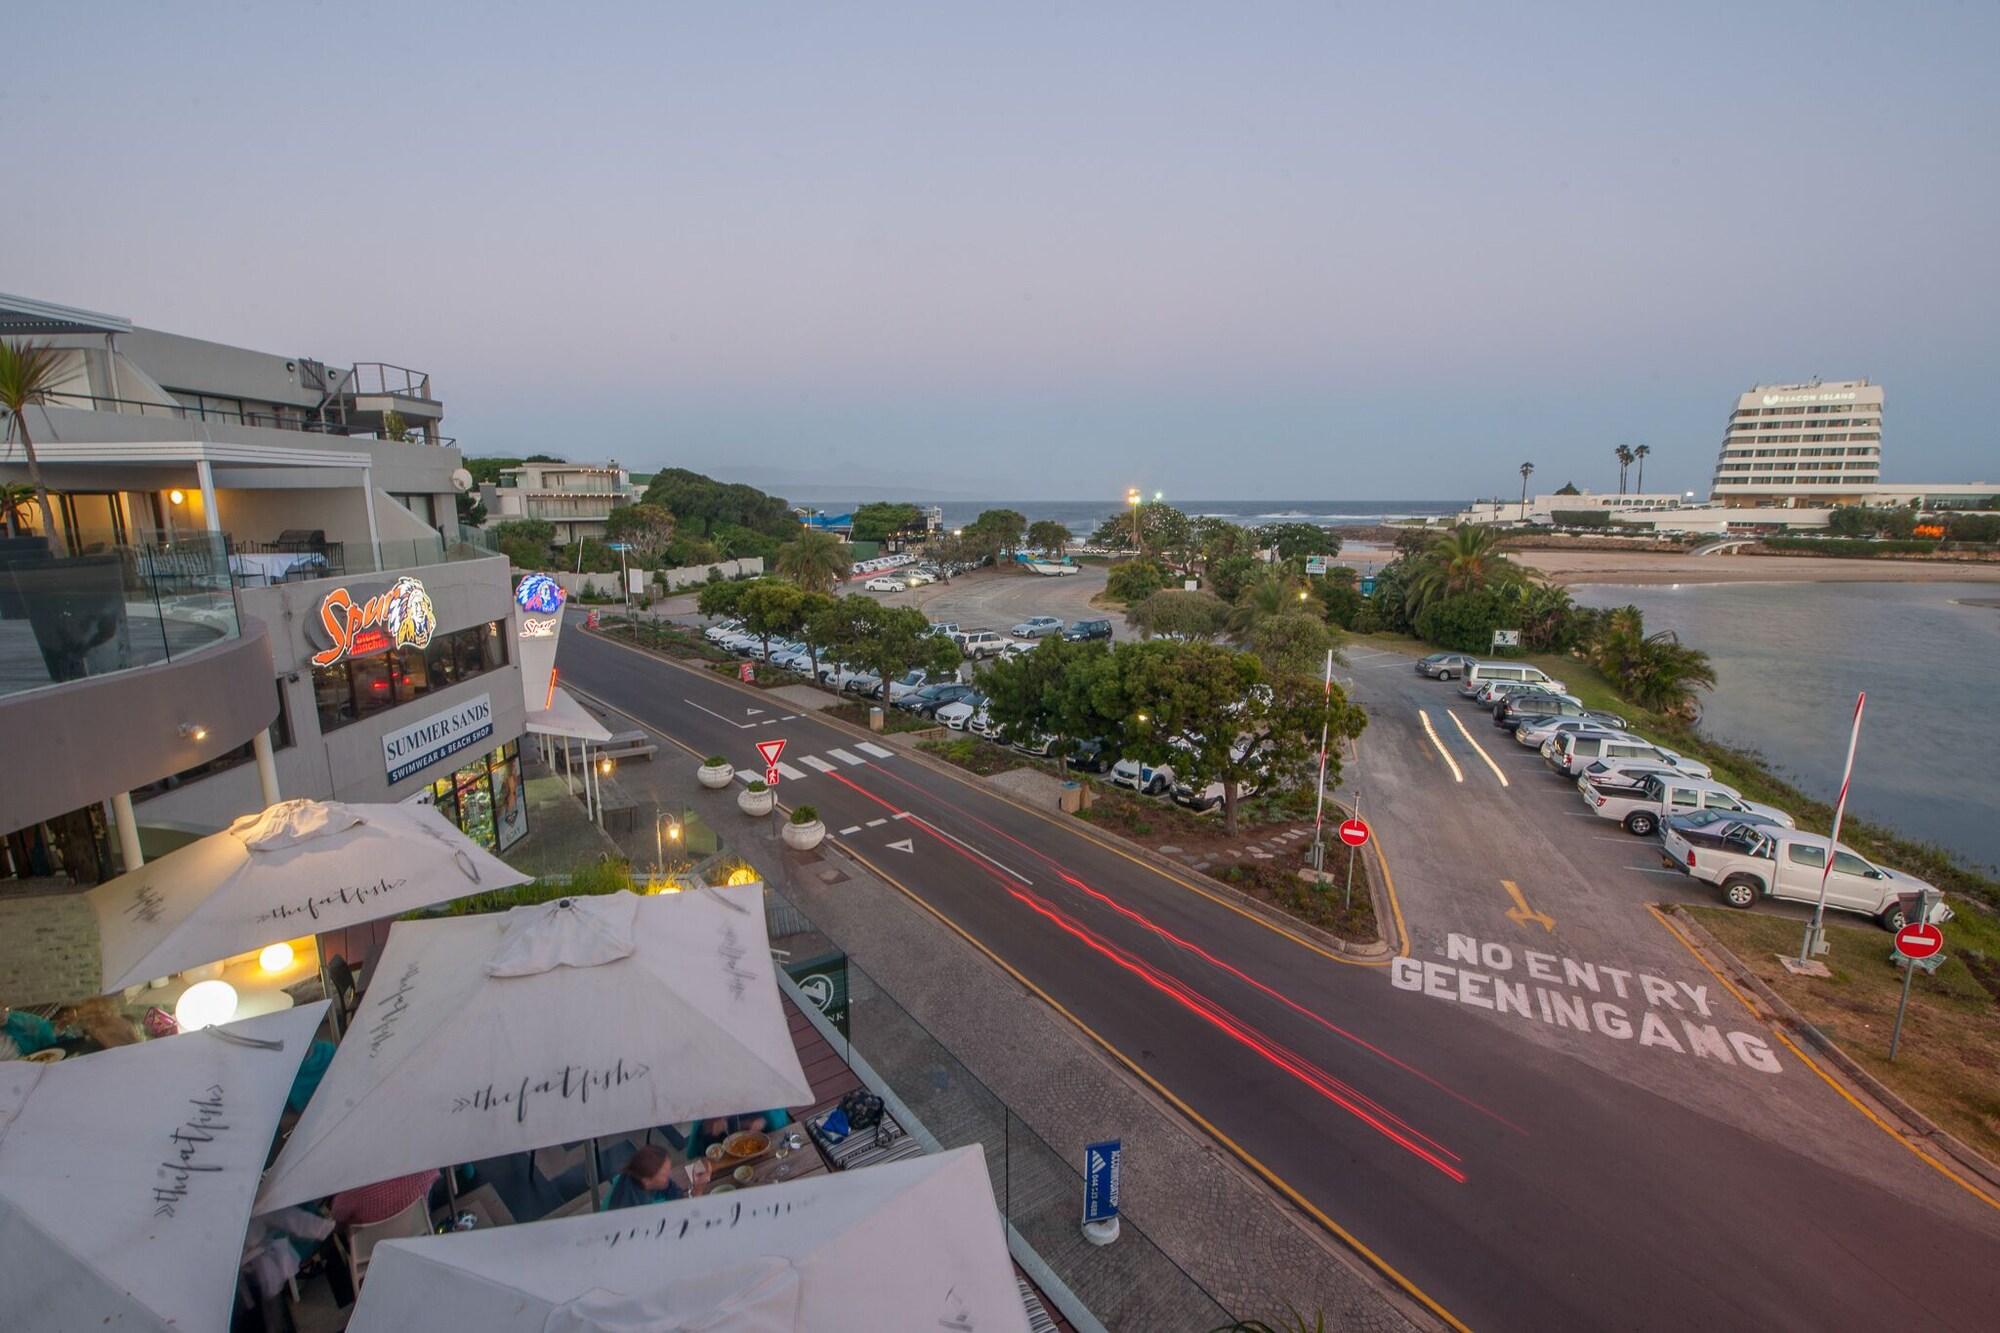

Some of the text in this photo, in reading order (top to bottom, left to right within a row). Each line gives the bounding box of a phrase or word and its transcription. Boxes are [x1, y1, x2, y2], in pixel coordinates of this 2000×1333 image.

[1820, 392, 1856, 402] ISLAND
[312, 588, 400, 668] Spur
[387, 702, 489, 761] SUMMER SANDS
[392, 726, 490, 782] SWIMWEAR & BEACH SHOP
[1447, 932, 1713, 1017] NO ENTRY
